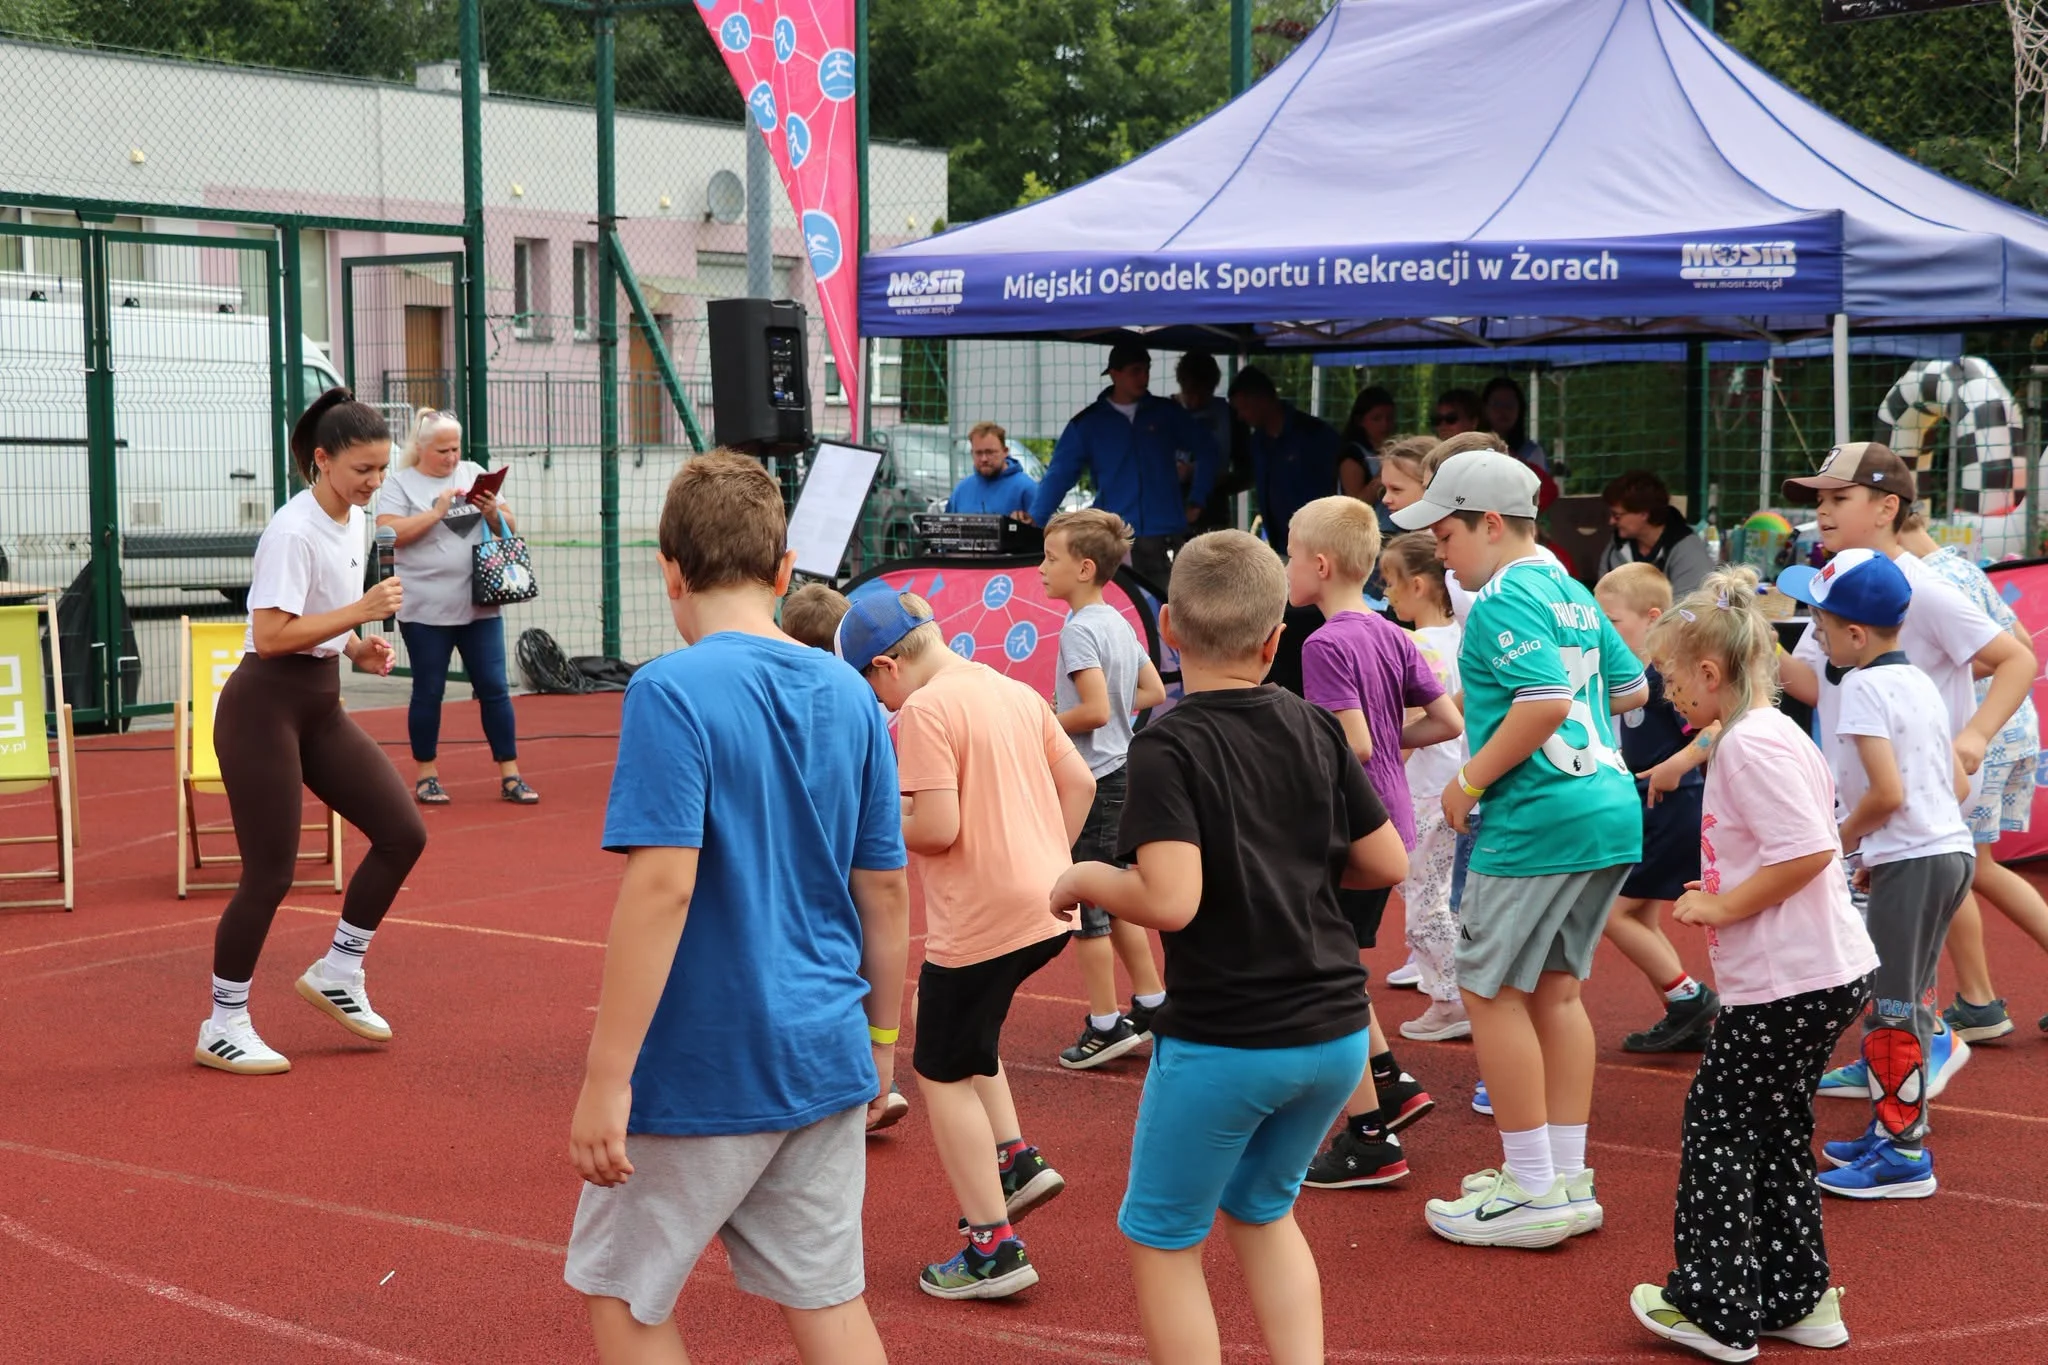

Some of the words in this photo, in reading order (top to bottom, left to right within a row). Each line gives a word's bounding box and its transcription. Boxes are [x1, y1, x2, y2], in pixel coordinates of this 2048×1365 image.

[1003, 268, 1091, 303] Miejski
[1099, 262, 1209, 294] Ośrodek
[1217, 262, 1310, 294] Sportu
[1318, 257, 1326, 285] i
[1334, 250, 1470, 286] Rekreacji
[1477, 258, 1503, 280] w
[1511, 245, 1619, 281] Żorach
